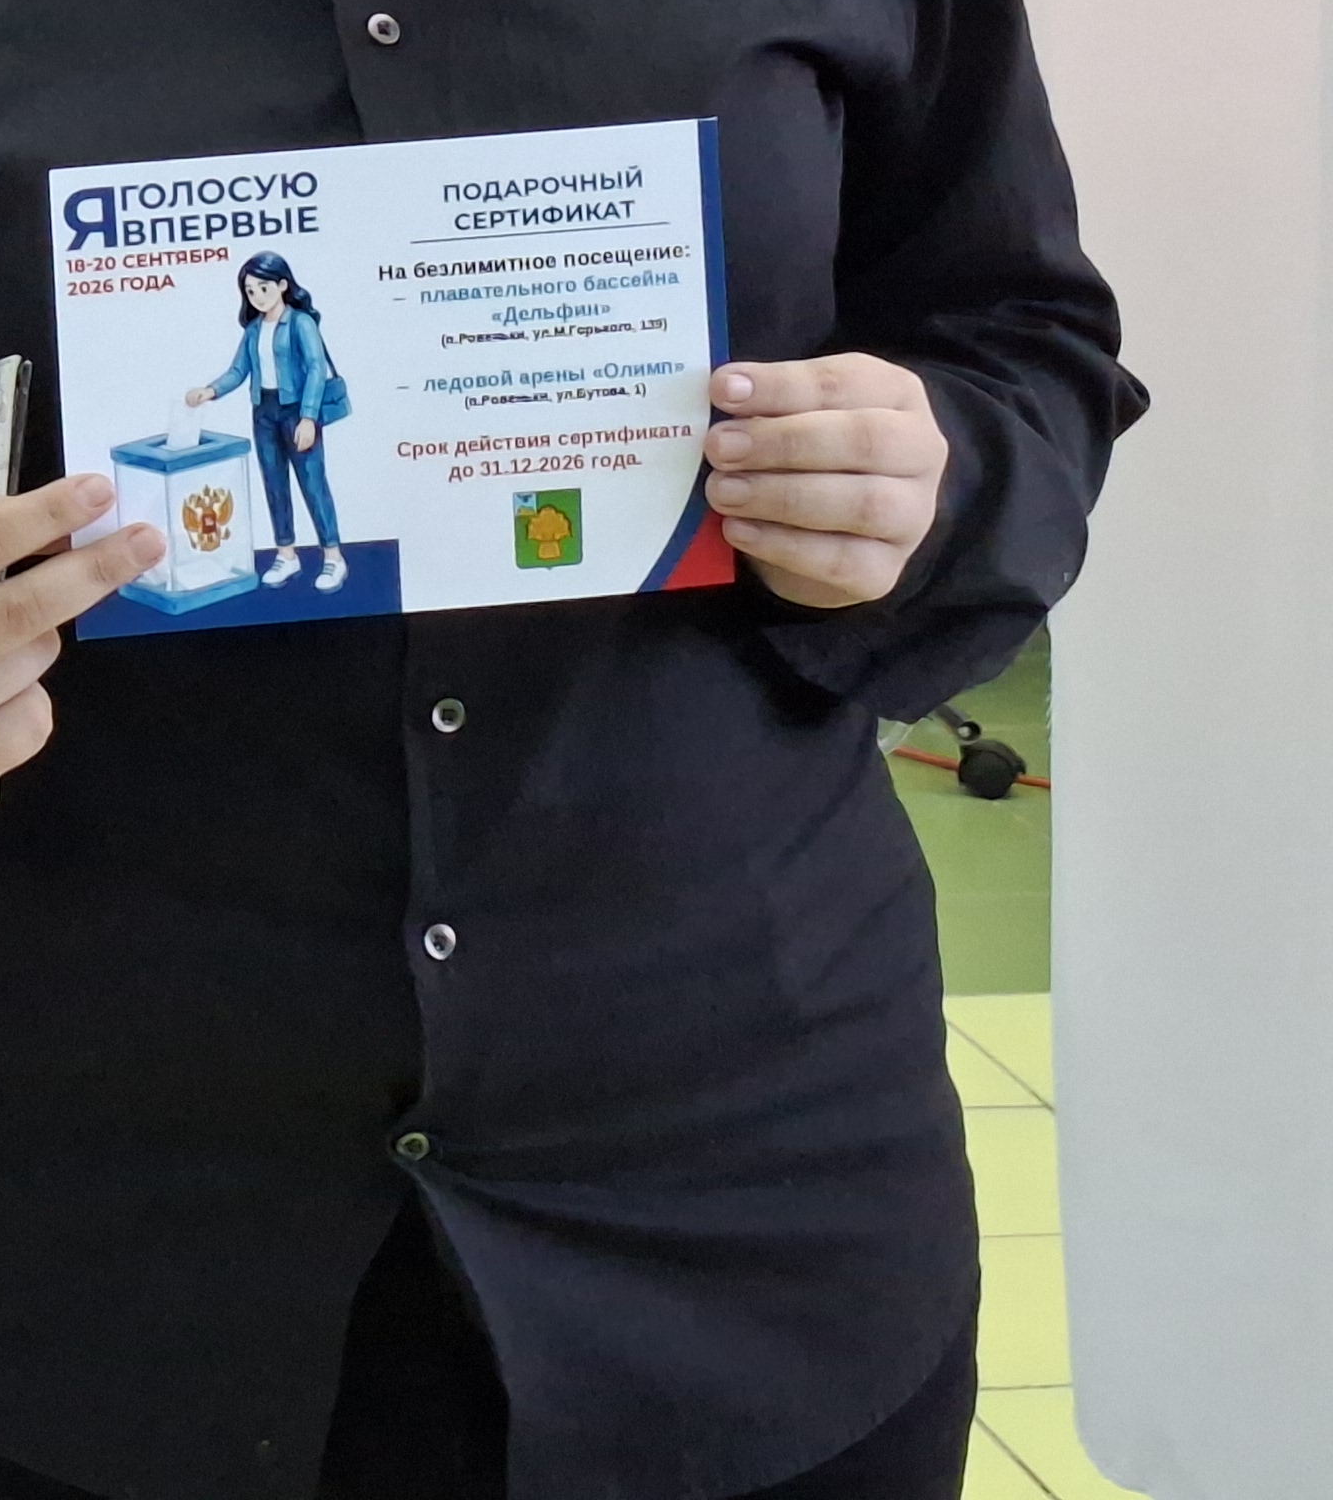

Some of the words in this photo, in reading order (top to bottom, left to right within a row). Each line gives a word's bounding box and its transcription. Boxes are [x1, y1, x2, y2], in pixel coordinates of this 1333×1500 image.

[443, 165, 644, 203] ПОДАРОЧНЫЙ
[63, 186, 118, 251] Я
[120, 171, 319, 211] ГОЛОСУЮ
[122, 206, 320, 247] ВПЕРВЫЕ
[454, 200, 637, 231] СЕРТИФИКАТ
[65, 256, 116, 274] 18-20
[122, 247, 230, 269] СЕНТЯБРЯ
[378, 265, 407, 281] На
[413, 253, 557, 280] безлимитное
[563, 243, 692, 270] посещение:
[67, 279, 115, 296] 2026
[120, 274, 176, 293] ГОДА
[420, 279, 577, 304] плавательного
[583, 269, 680, 293] бассейна
[491, 300, 612, 326] «Дельфин»
[423, 368, 514, 394] ледовой
[519, 366, 585, 389] арены
[592, 359, 686, 379] «Олимп»
[397, 437, 450, 461] Срок
[454, 429, 552, 458] действия
[557, 422, 693, 449] сертификата
[448, 464, 474, 484] до
[479, 453, 584, 478] 31.12.2026
[590, 453, 642, 472] года.
